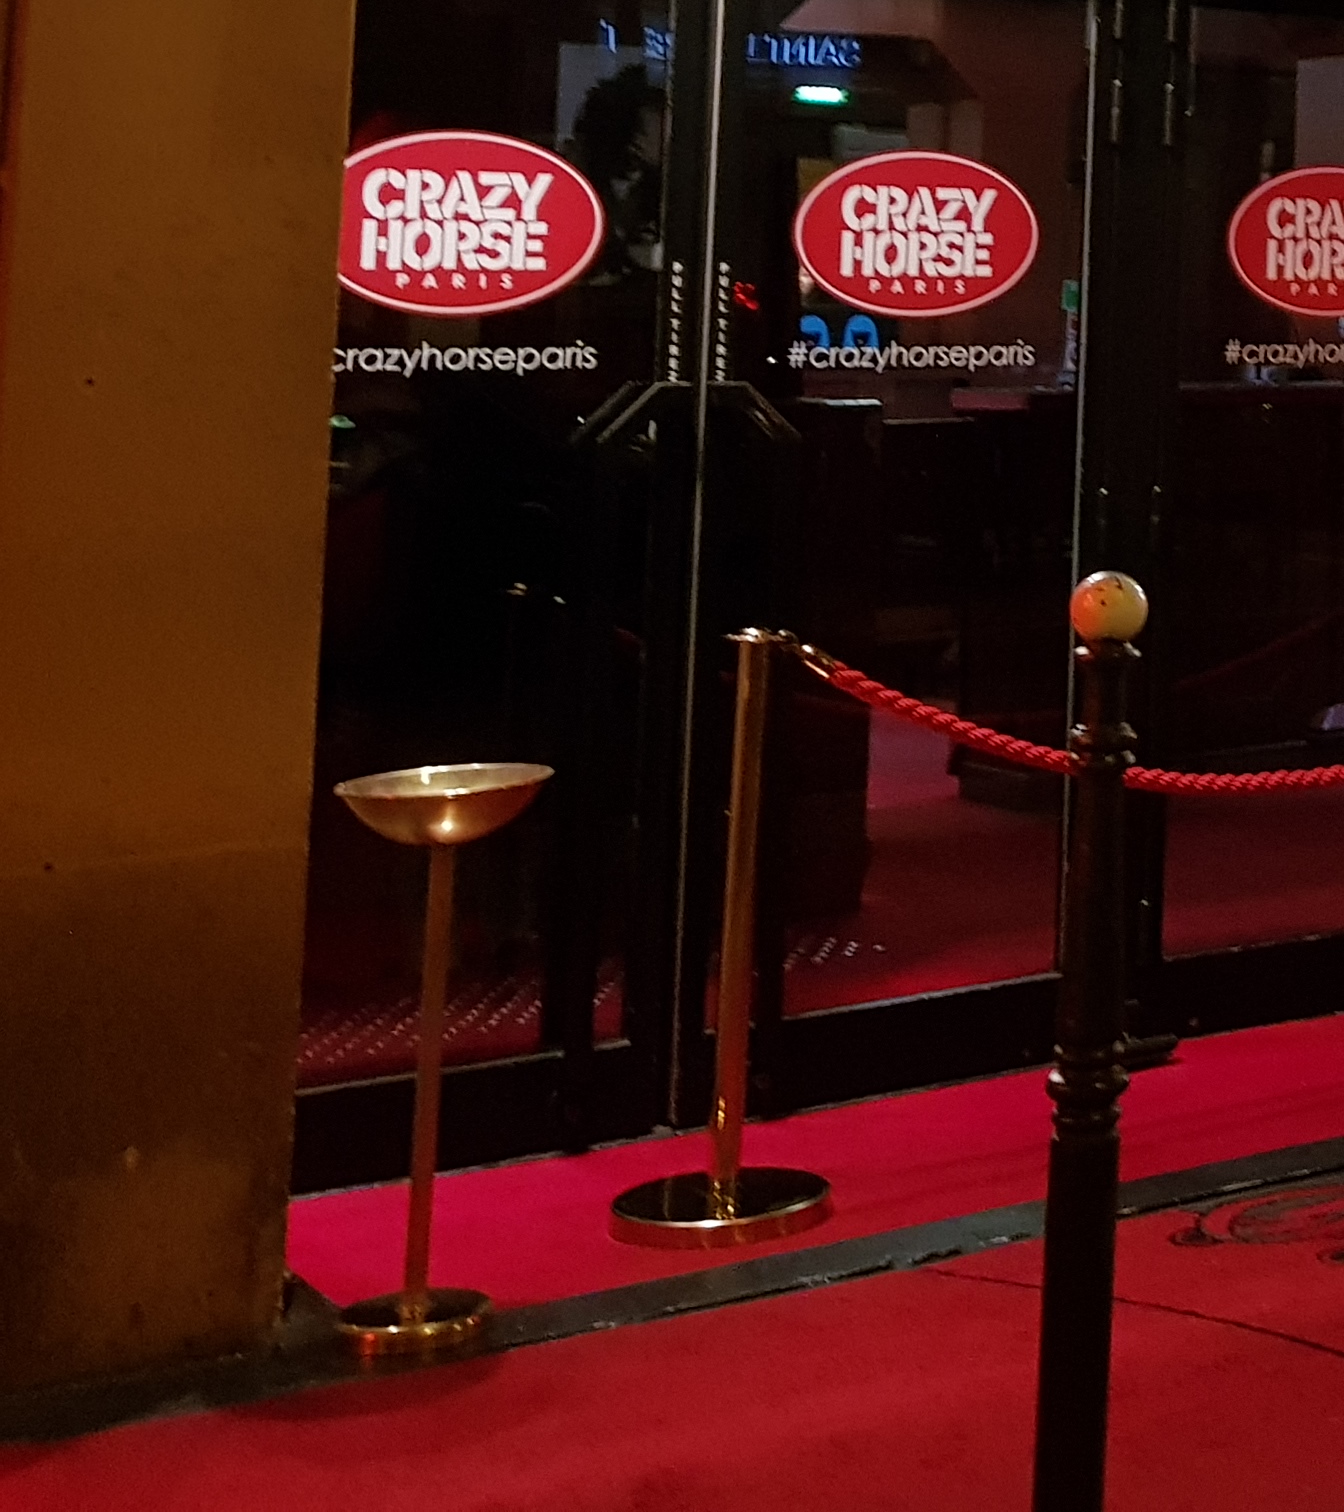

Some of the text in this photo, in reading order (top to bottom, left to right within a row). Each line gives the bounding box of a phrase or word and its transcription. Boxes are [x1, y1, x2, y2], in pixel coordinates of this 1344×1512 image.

[360, 168, 556, 223] CRAZY
[840, 185, 998, 234] CRAZY
[360, 218, 549, 274] HORSE
[839, 230, 994, 278] HORSE
[395, 271, 516, 292] PARIS
[868, 278, 967, 296] PARIS
[787, 338, 1036, 374] #crazyhorseparis
